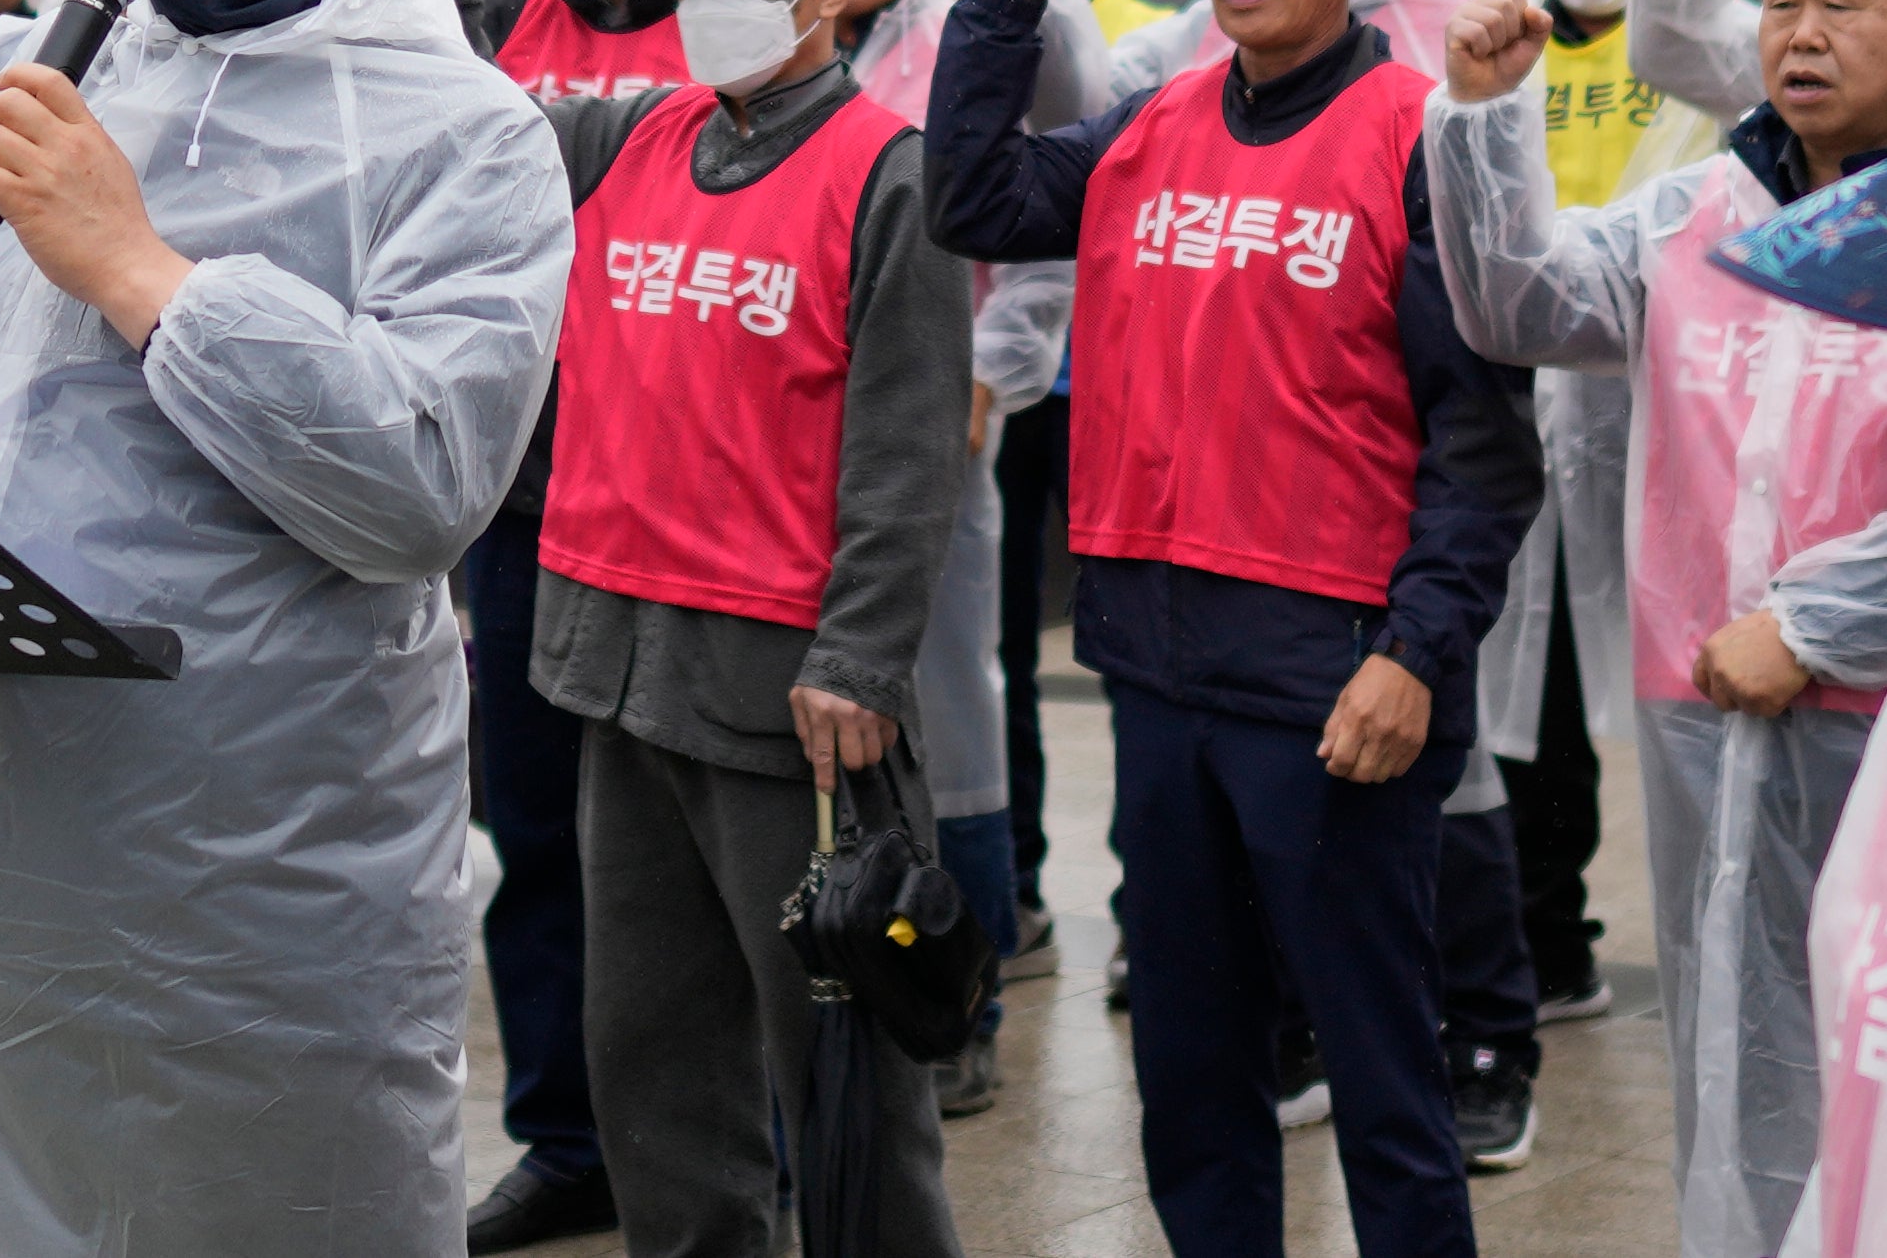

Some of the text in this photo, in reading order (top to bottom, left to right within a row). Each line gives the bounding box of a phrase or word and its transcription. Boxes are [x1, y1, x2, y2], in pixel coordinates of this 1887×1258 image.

[1546, 78, 1661, 132] 결투쟁
[1133, 189, 1354, 289] 단결투쟁
[607, 240, 798, 337] 단결투쟁
